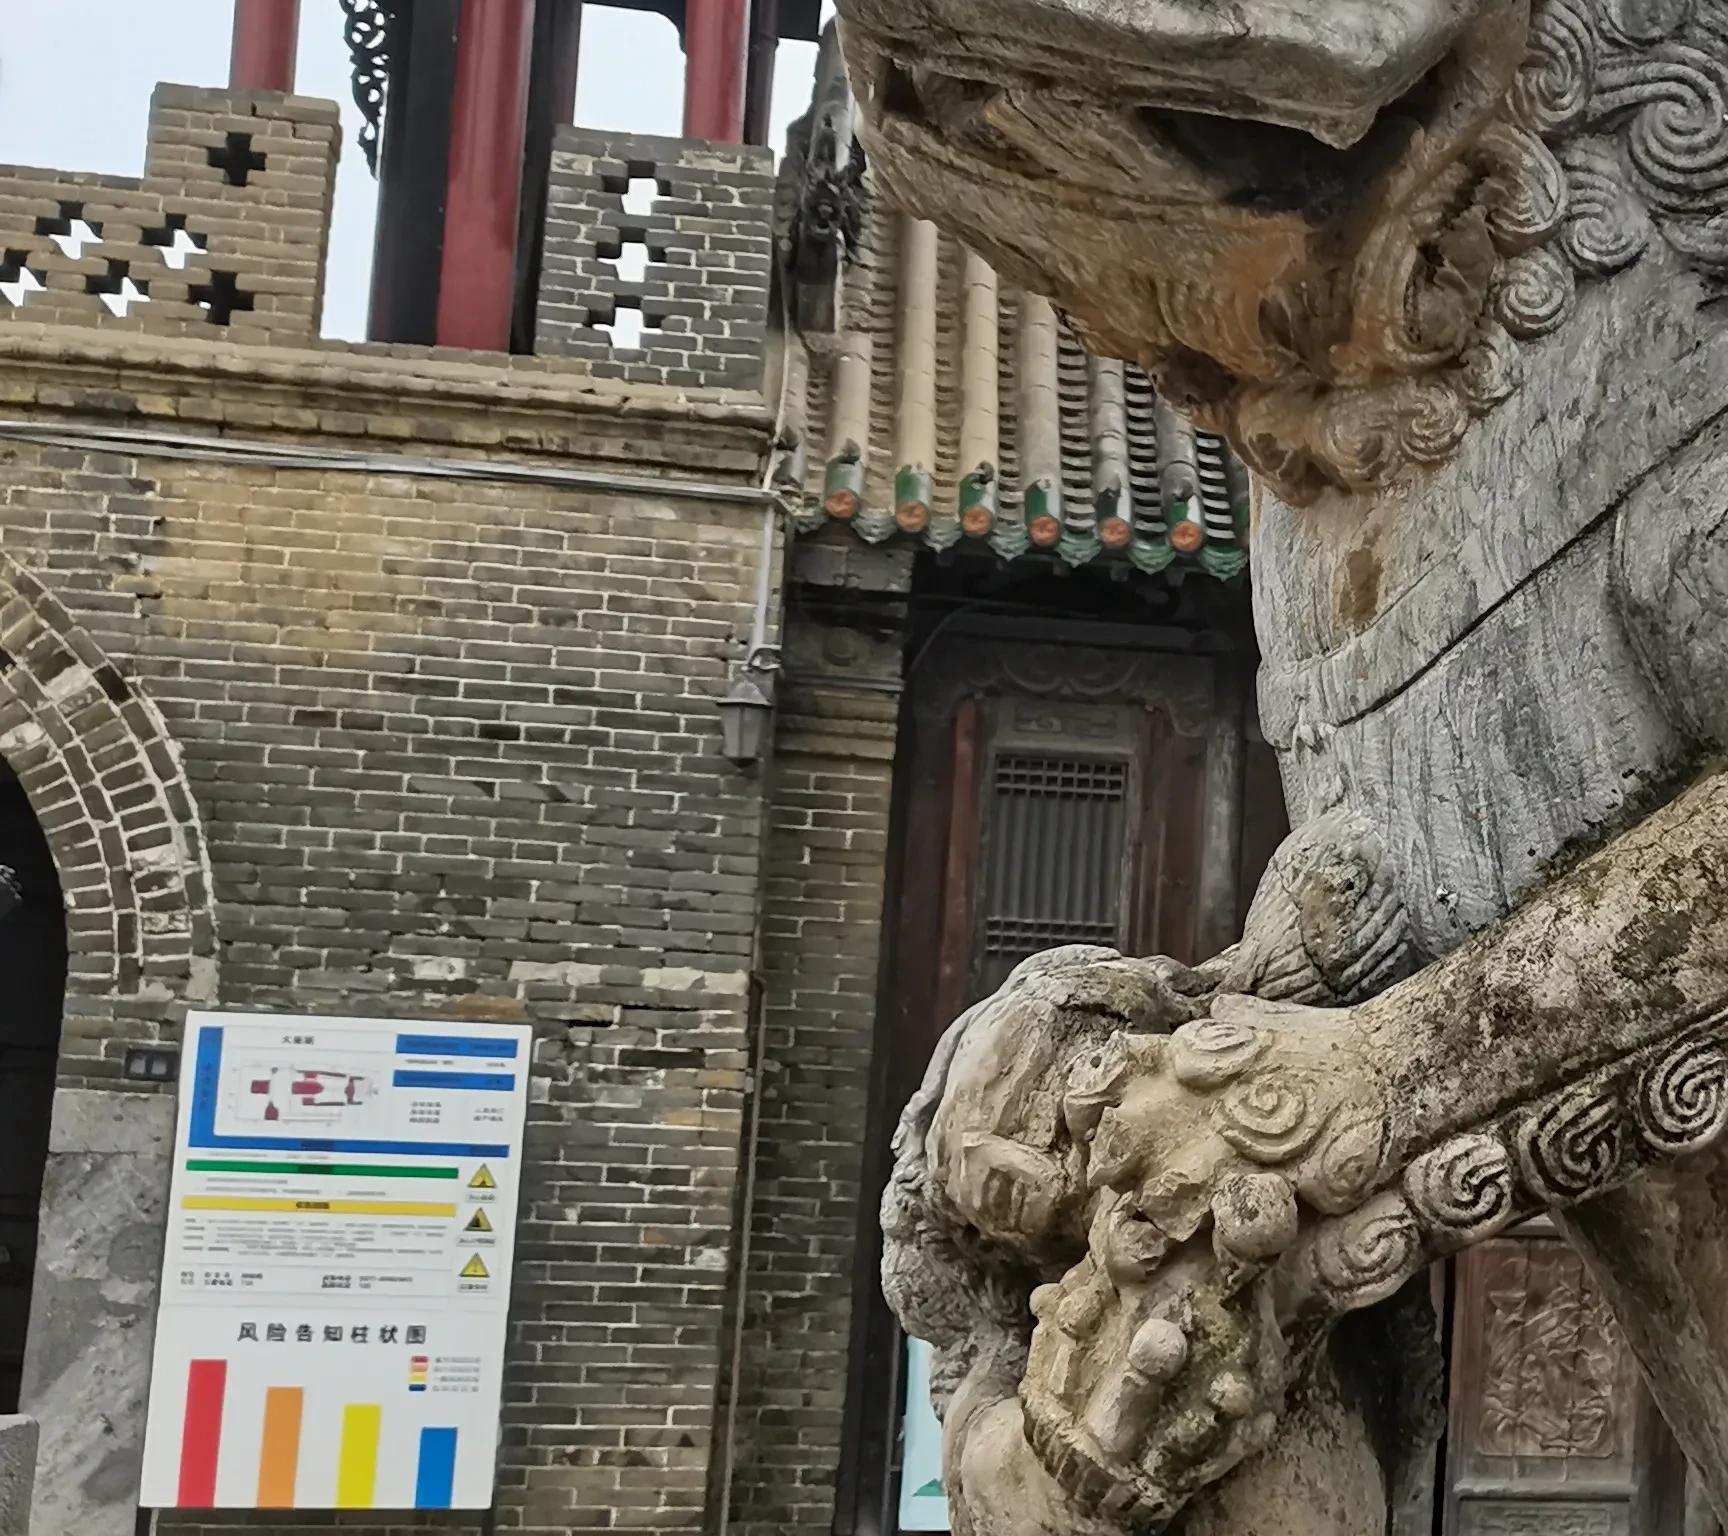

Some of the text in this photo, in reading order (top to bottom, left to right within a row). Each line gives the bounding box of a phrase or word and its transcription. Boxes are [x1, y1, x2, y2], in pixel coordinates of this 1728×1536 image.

[237, 1322, 427, 1345] 风险告知柱状图
